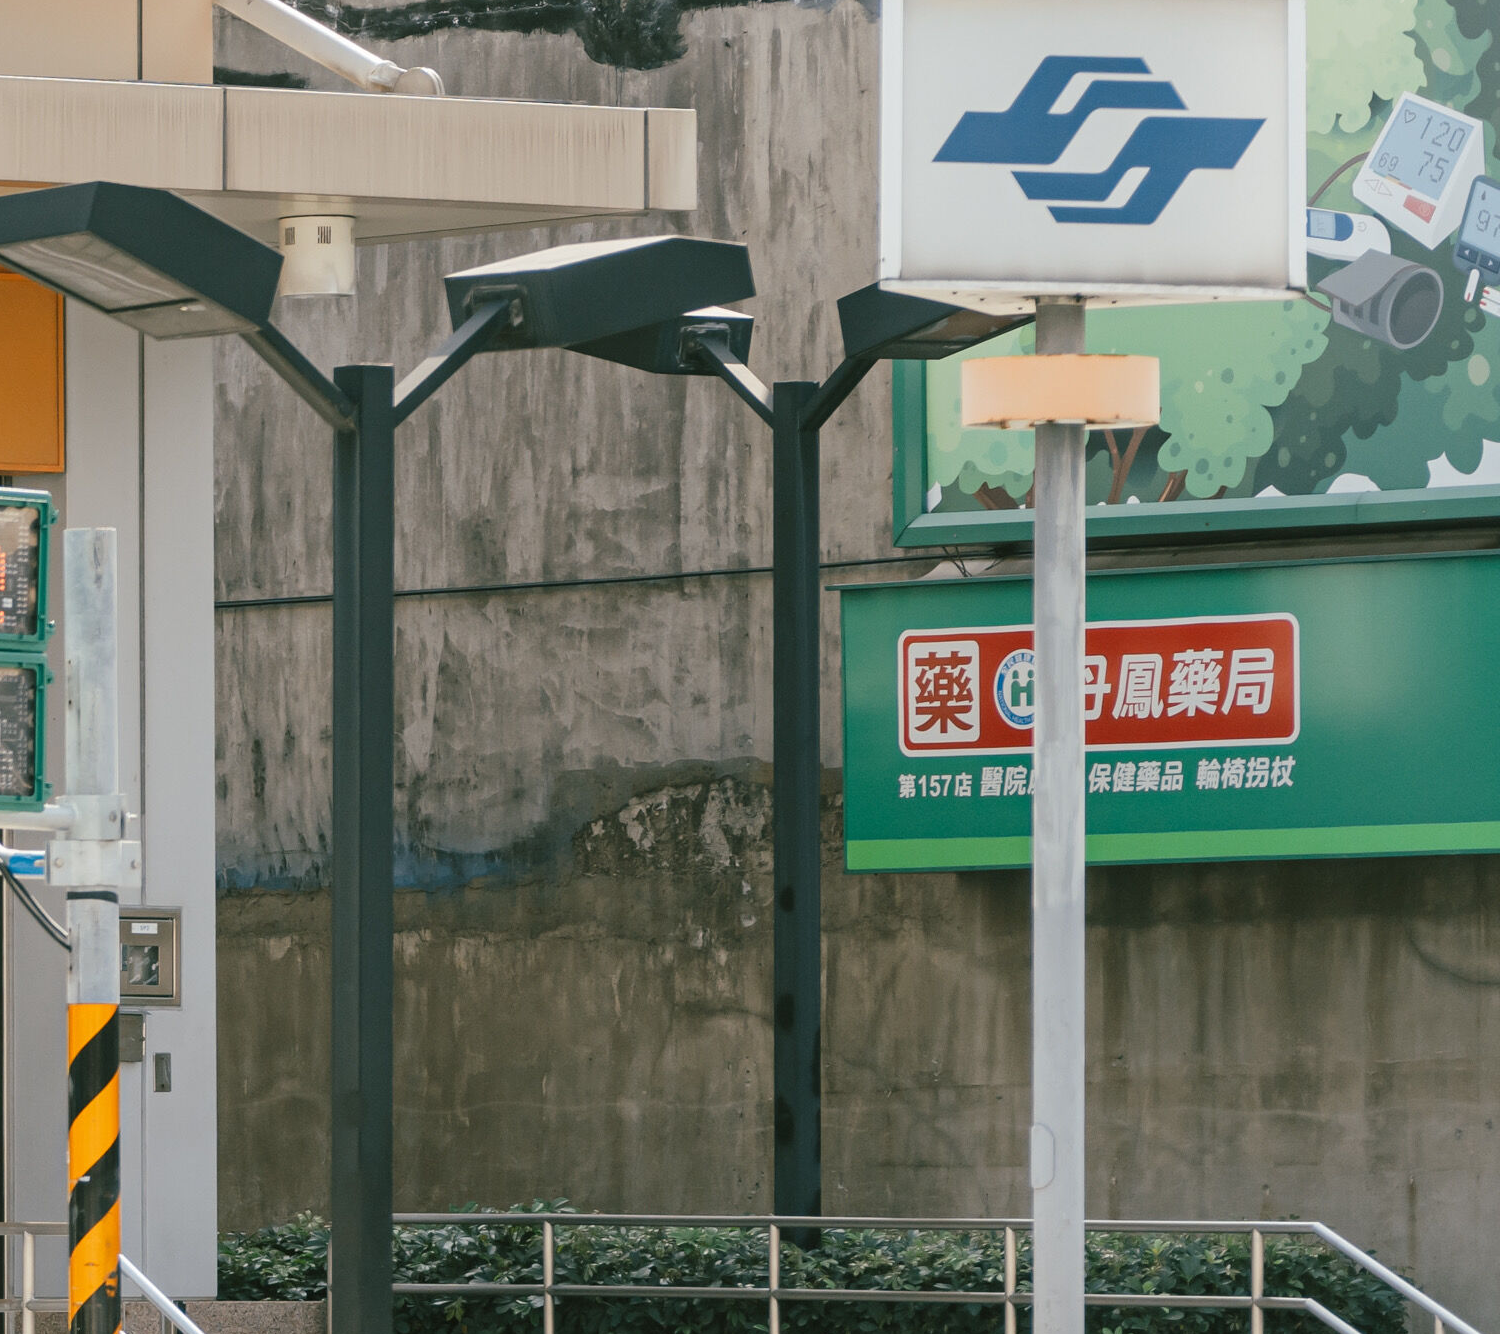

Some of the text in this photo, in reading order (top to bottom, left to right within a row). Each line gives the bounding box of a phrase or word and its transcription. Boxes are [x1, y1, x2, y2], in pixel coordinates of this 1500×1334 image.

[1420, 115, 1465, 153] 120
[1378, 152, 1399, 172] 69
[1418, 150, 1449, 183] 75
[914, 650, 974, 734] 藥
[898, 773, 973, 798] 第157店
[1088, 761, 1184, 793] 保健藥品
[1196, 755, 1296, 790] 輪椅拐杖
